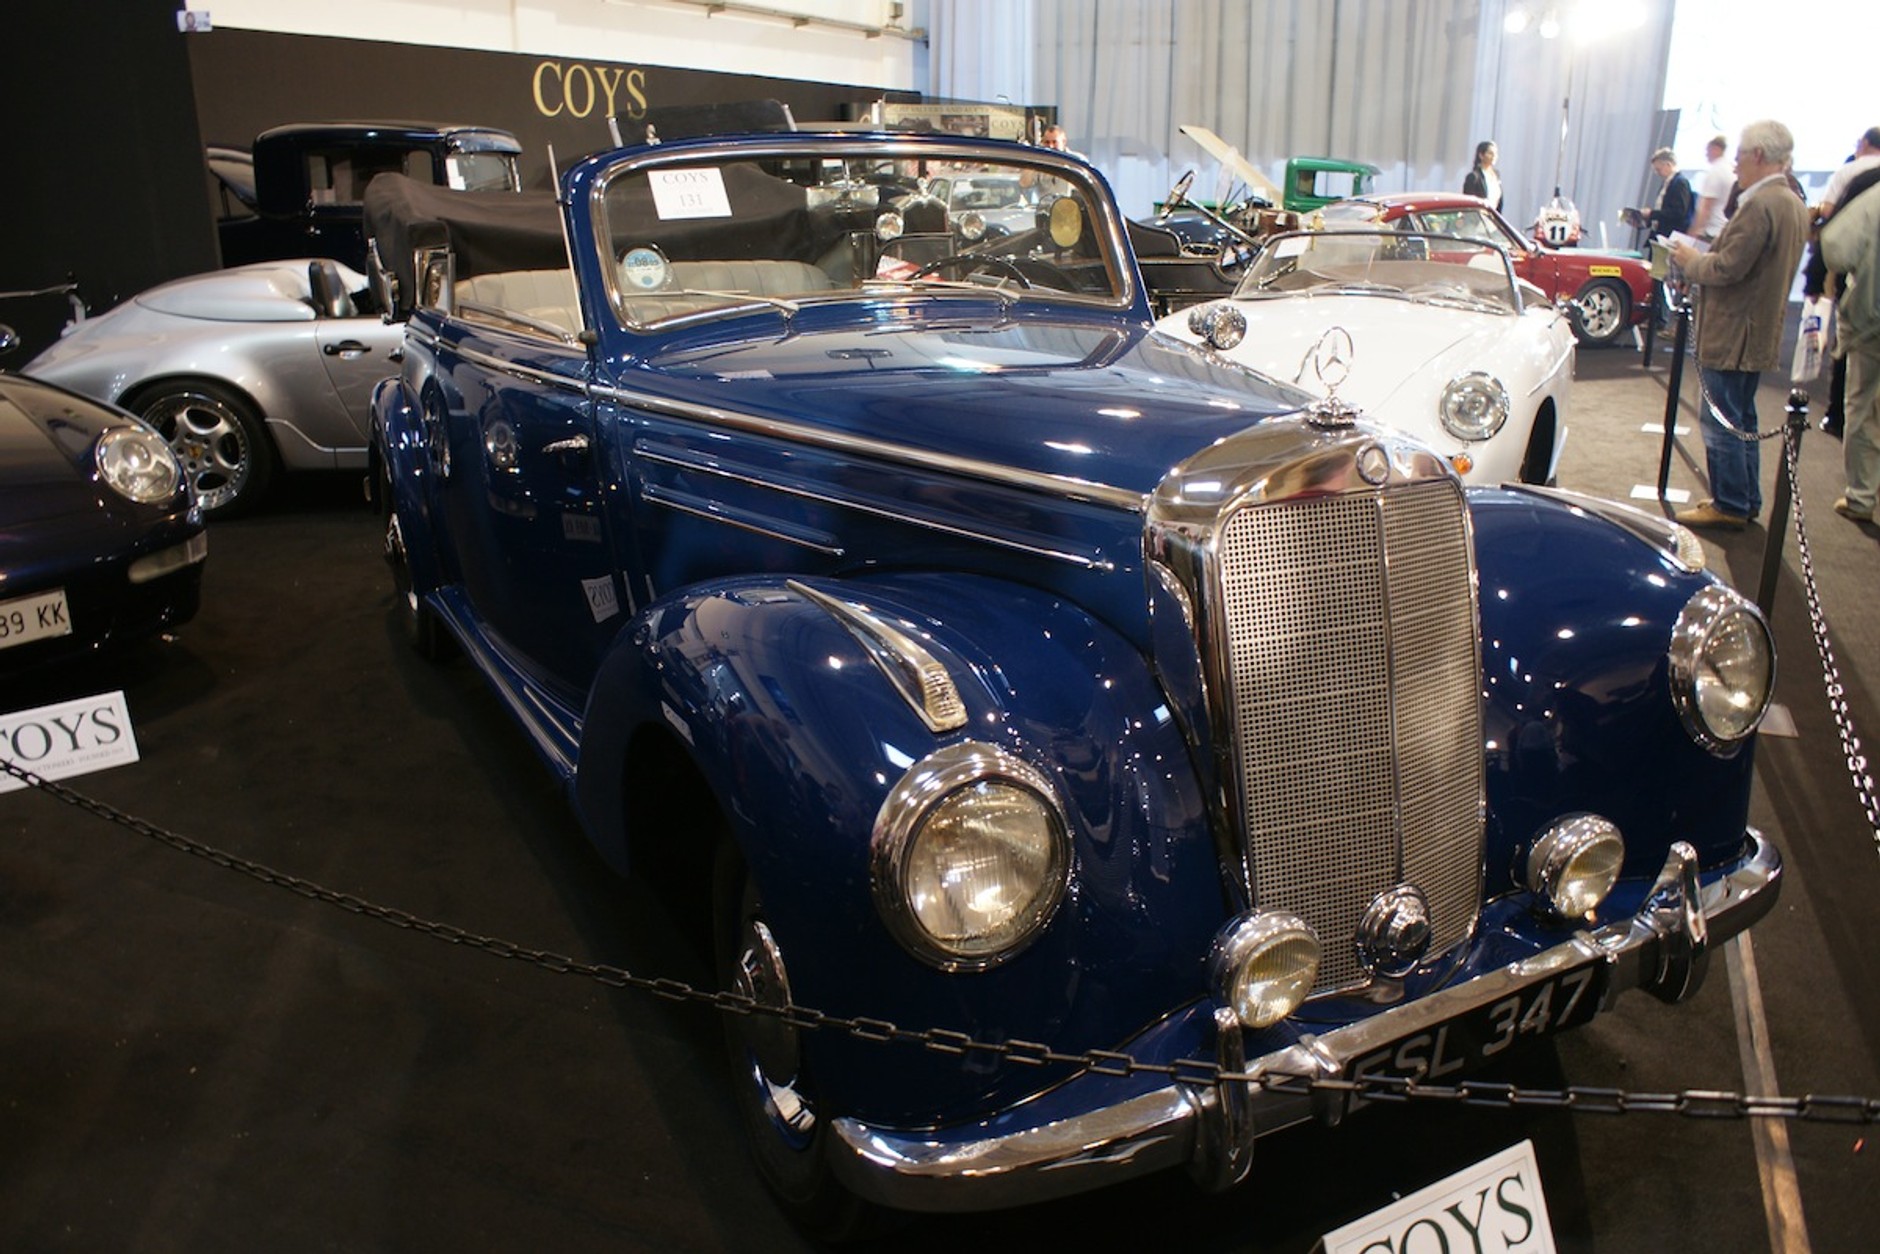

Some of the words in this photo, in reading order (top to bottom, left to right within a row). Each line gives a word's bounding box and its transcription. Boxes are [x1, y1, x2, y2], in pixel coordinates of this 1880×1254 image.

[533, 61, 647, 119] COYS
[662, 172, 708, 184] COYS
[680, 193, 703, 207] 131
[1550, 225, 1565, 241] 11
[37, 602, 66, 629] KK
[0, 706, 121, 762] OYS
[1482, 966, 1594, 1056] 347
[1360, 1171, 1533, 1254] YS
